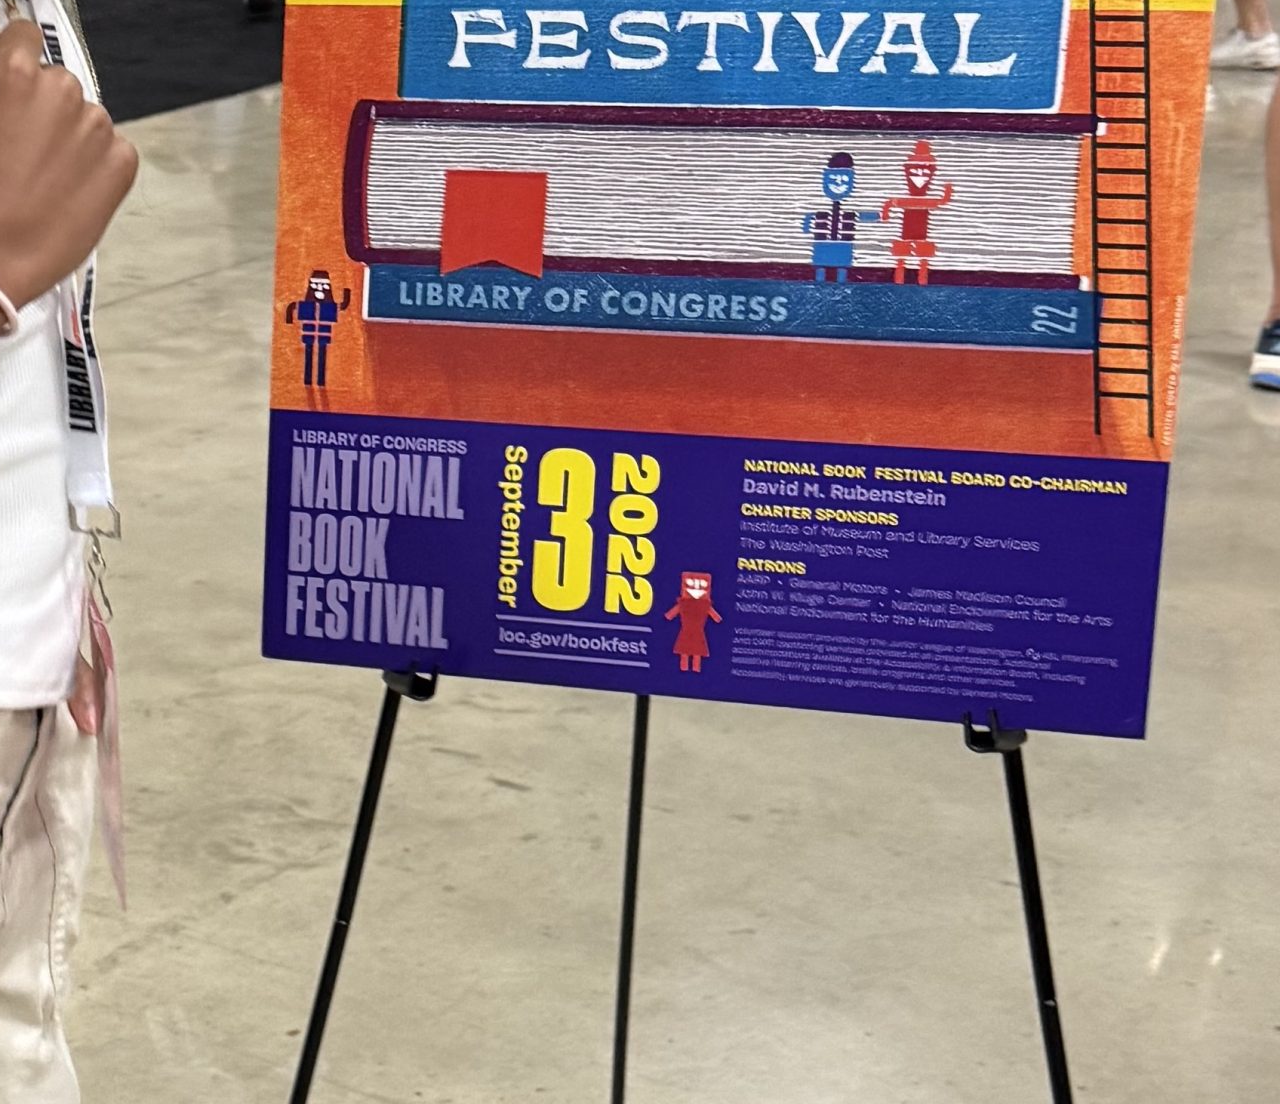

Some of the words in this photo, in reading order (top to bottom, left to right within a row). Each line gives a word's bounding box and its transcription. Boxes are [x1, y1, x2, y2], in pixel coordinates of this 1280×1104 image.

[447, 7, 1019, 78] FESTIVAL
[399, 281, 534, 311] LIBRARY
[543, 286, 589, 313] OF
[600, 290, 789, 322] CONGRESS
[293, 429, 357, 447] LIBRARY
[360, 433, 381, 448] OF
[383, 435, 467, 454] CONGRESS
[291, 447, 465, 520] NATIONAL
[743, 478, 798, 496] David
[803, 482, 825, 499] M.
[831, 484, 946, 507] Rubenstein
[744, 459, 819, 476] NATIONAL
[823, 464, 866, 479] BOOK
[874, 467, 947, 484] FESTIVAL
[951, 471, 1005, 487] BOARD
[1009, 475, 1127, 495] CO-CHAIRMAN
[497, 445, 528, 609] September
[532, 448, 596, 611] 3
[603, 452, 661, 616] 2022
[741, 503, 812, 520] CHARTER
[815, 508, 899, 526] SPONSORS
[288, 511, 390, 580] BOOK
[737, 557, 807, 575] PATRONS
[286, 574, 449, 649] FESTIVAL
[498, 626, 648, 656] loc.gov/bookfest
